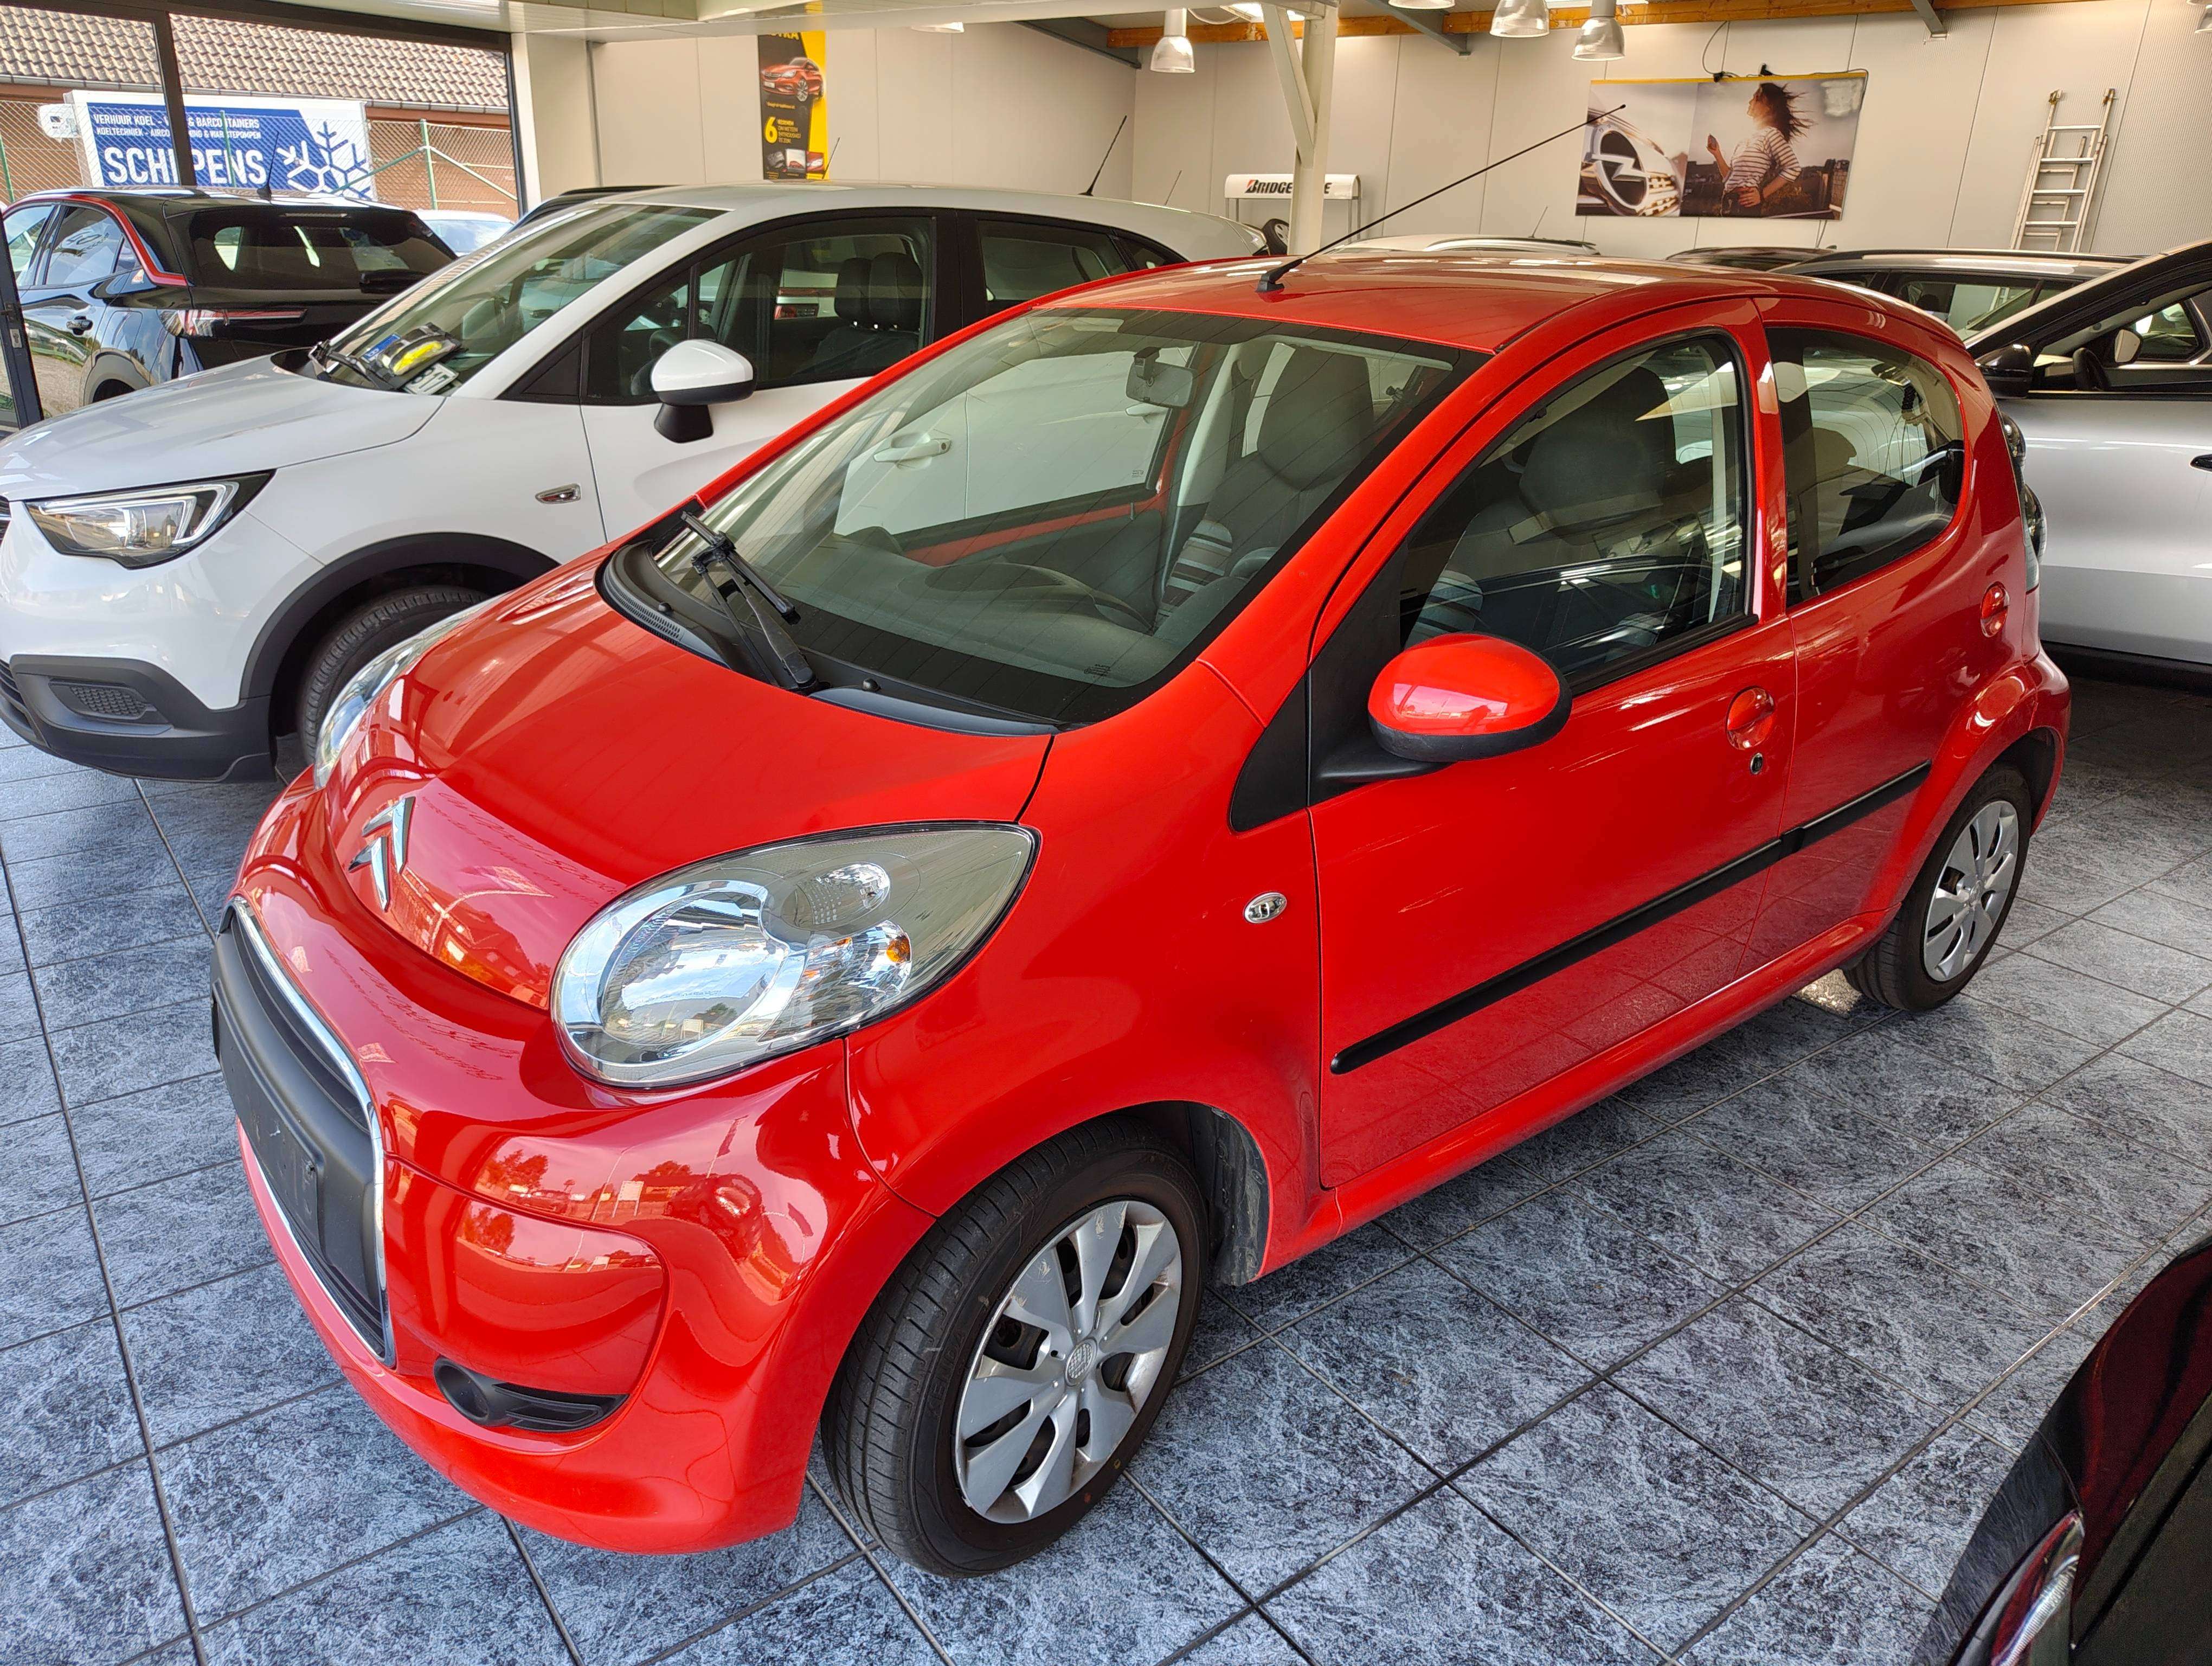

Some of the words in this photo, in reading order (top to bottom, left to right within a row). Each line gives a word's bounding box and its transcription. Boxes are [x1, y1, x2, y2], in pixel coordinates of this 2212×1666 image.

[93, 114, 131, 125] VERHUUR
[134, 115, 156, 126] KOEL
[765, 117, 777, 144] 6
[1245, 179, 1333, 194] BRIDGEE
